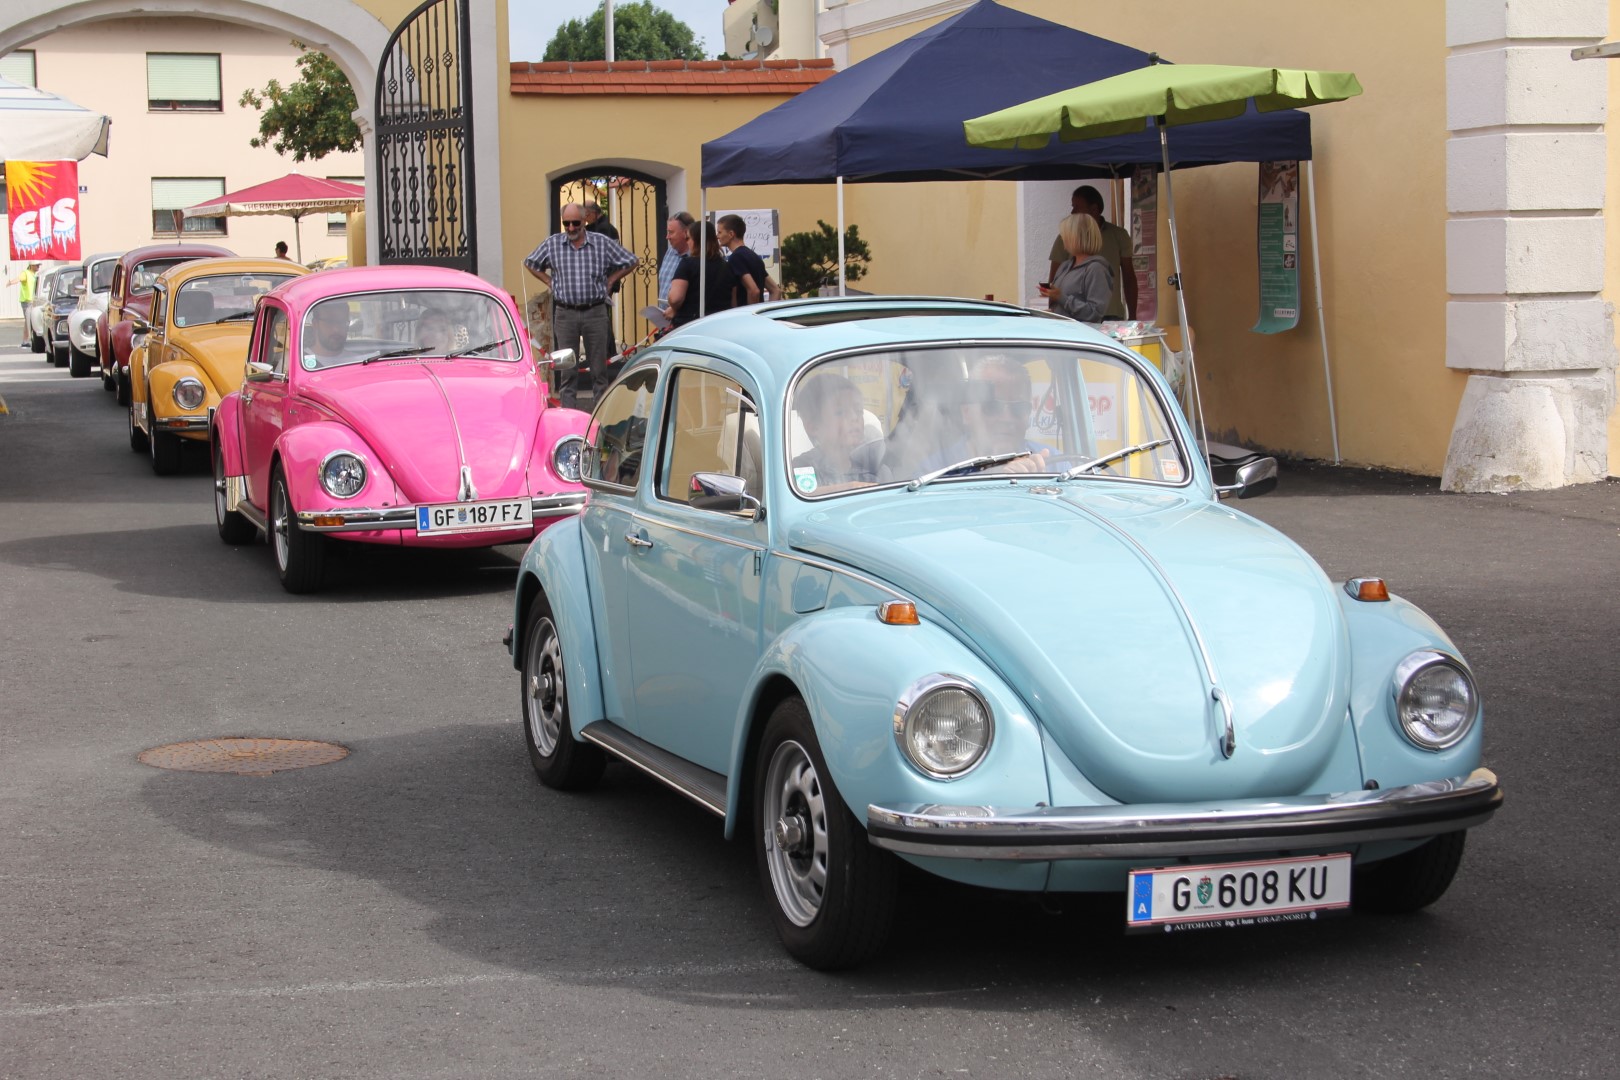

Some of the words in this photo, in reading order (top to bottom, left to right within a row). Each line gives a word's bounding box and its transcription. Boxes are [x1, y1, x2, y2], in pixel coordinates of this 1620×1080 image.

[285, 200, 337, 208] KONDITOREI
[12, 197, 77, 259] EIS
[434, 509, 455, 526] GF
[469, 506, 497, 524] 187
[502, 503, 523, 521] FZ
[1172, 876, 1191, 912] G
[1218, 870, 1279, 908] 608
[1288, 866, 1327, 903] KU
[1137, 902, 1148, 914] A
[1173, 920, 1222, 931] AUTOHAUS
[1256, 912, 1307, 924] GRAZ-NORD
